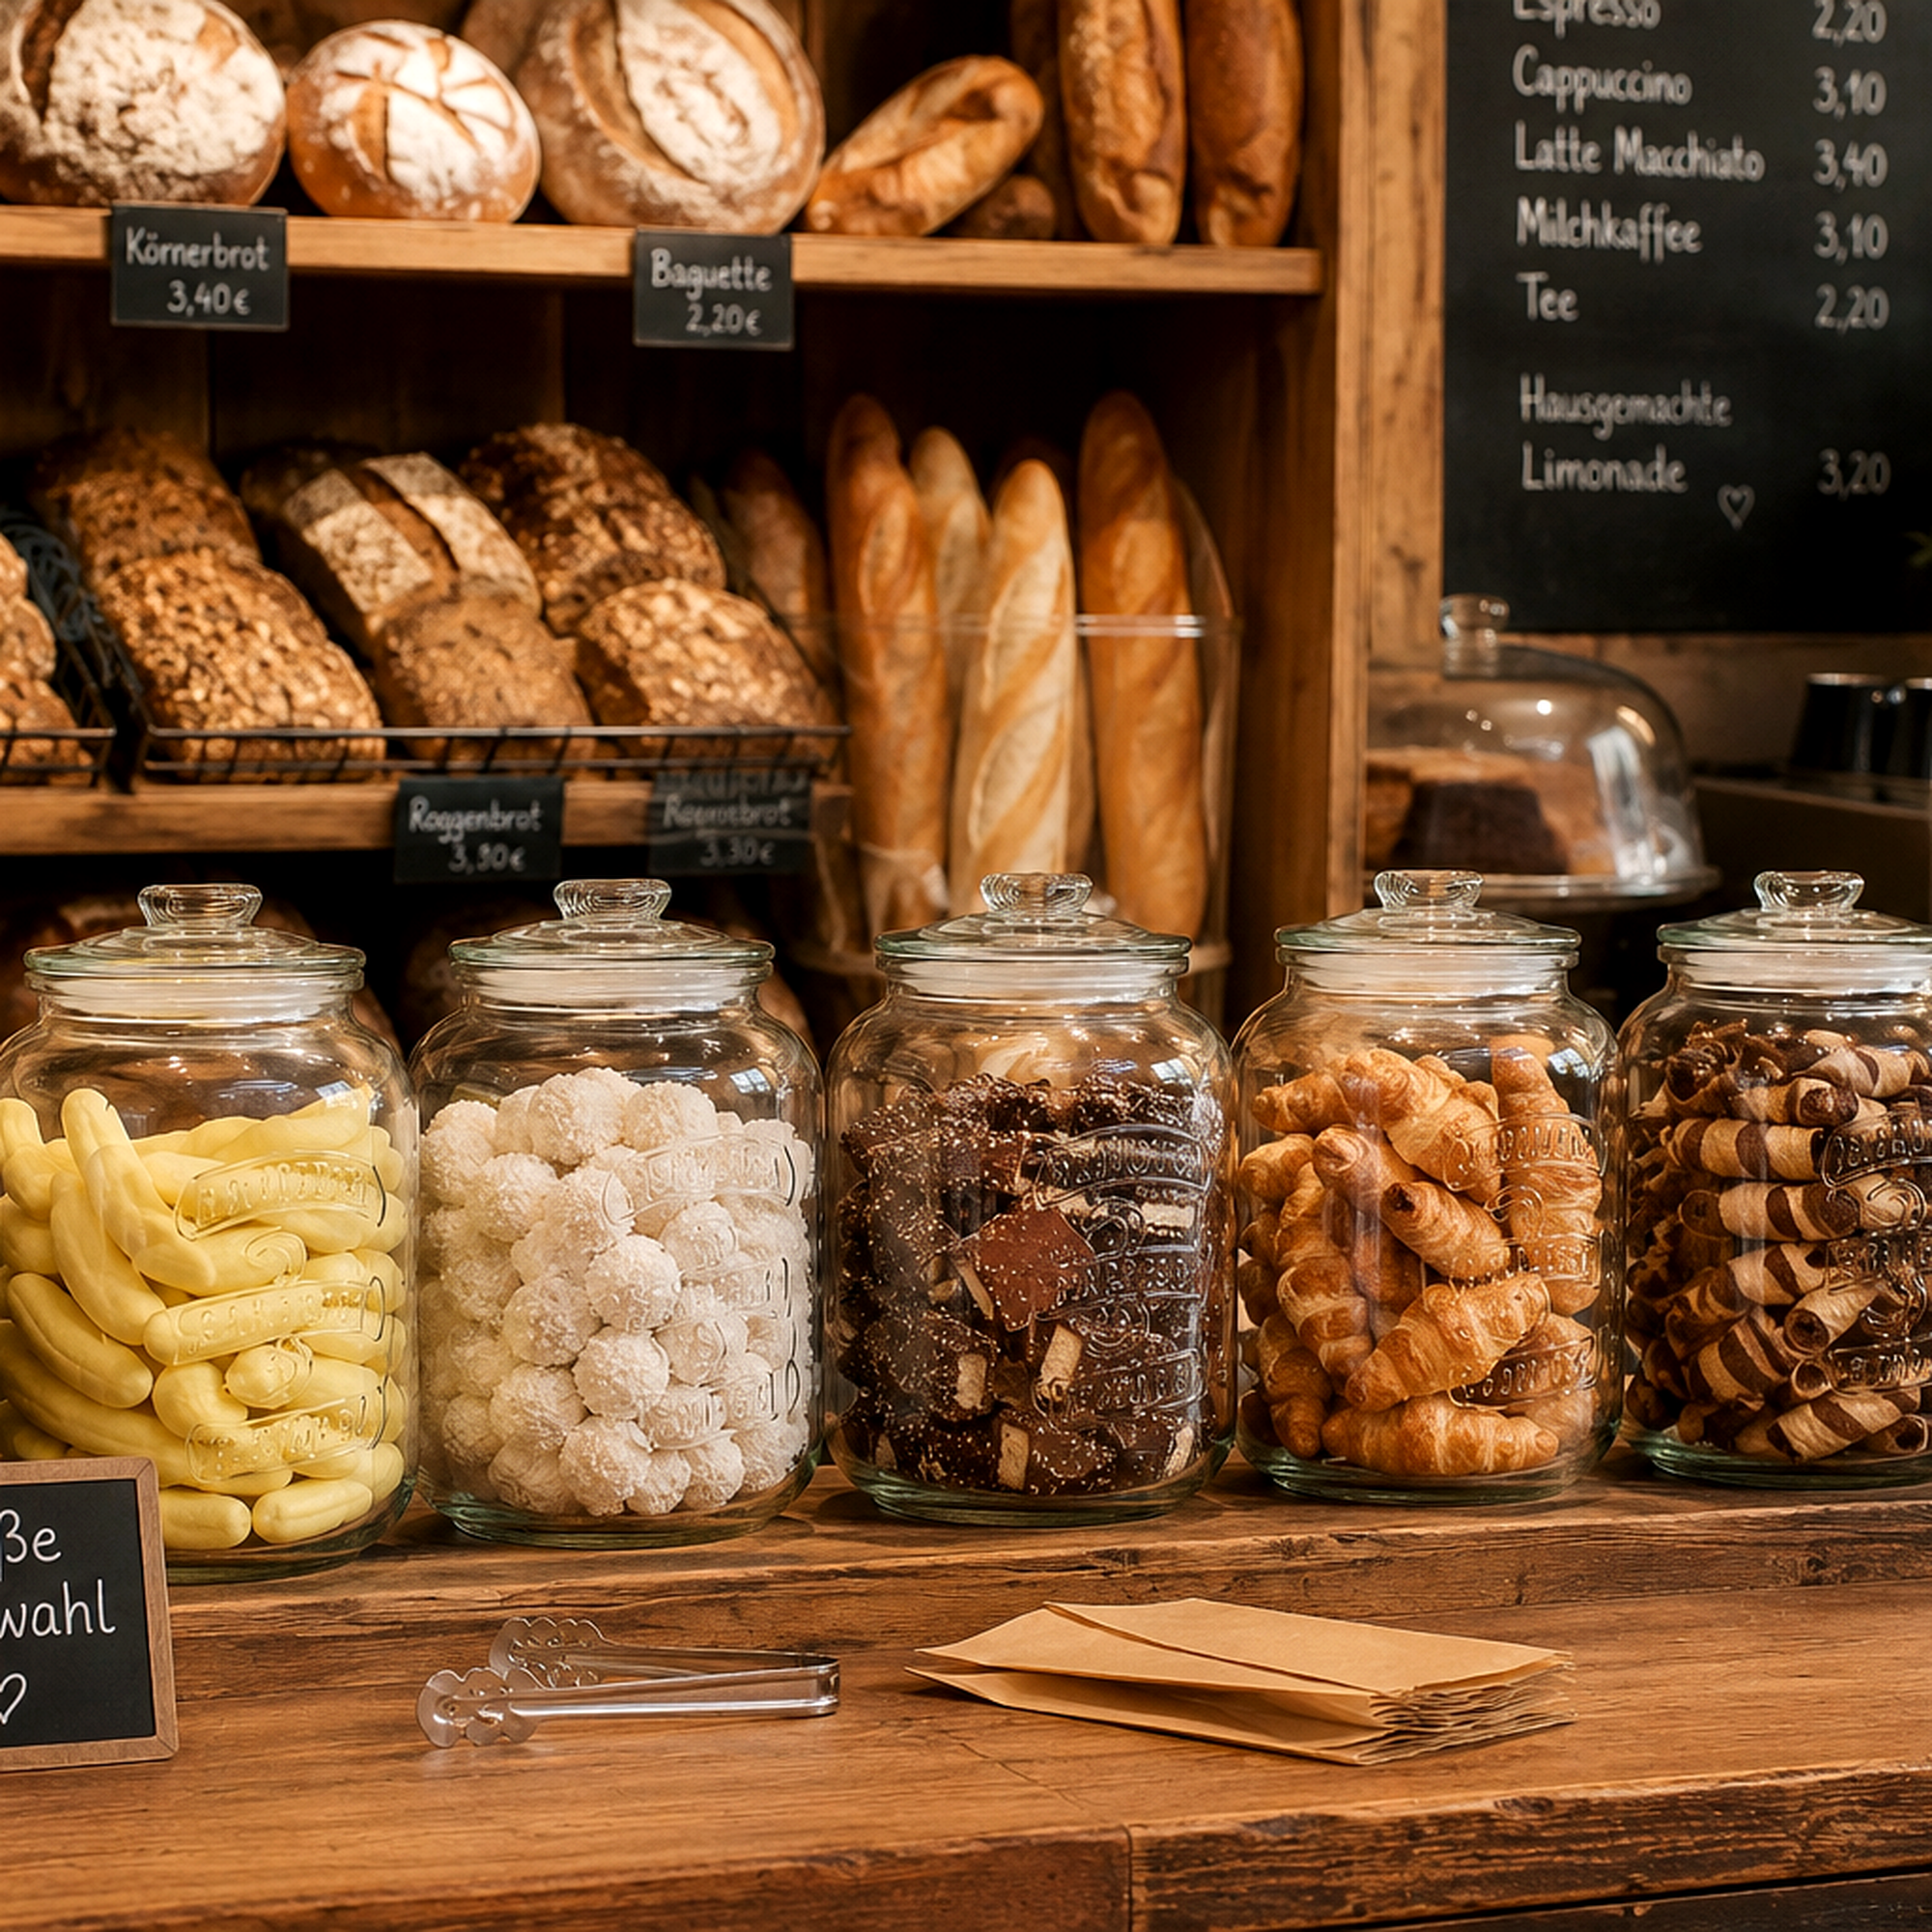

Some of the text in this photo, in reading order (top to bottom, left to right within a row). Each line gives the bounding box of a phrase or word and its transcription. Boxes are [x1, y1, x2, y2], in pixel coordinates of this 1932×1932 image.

[1812, 0, 1888, 46] 2,20
[1513, 44, 1888, 120] Cappuccino 3,10
[1515, 120, 1889, 191] Latte Macchiato 3,40
[126, 225, 270, 271] Körnerbrot
[1517, 196, 1889, 264] Milchkaffee 3,10
[166, 279, 251, 317] 3,40€
[649, 246, 772, 301] Baguette
[1516, 271, 1890, 333] Tee 2,20
[685, 302, 761, 336] 2,20€
[1520, 373, 1733, 440] Hausgemachte
[1521, 440, 1891, 498] Limonade 3,20
[0, 1577, 116, 1639] wahl
